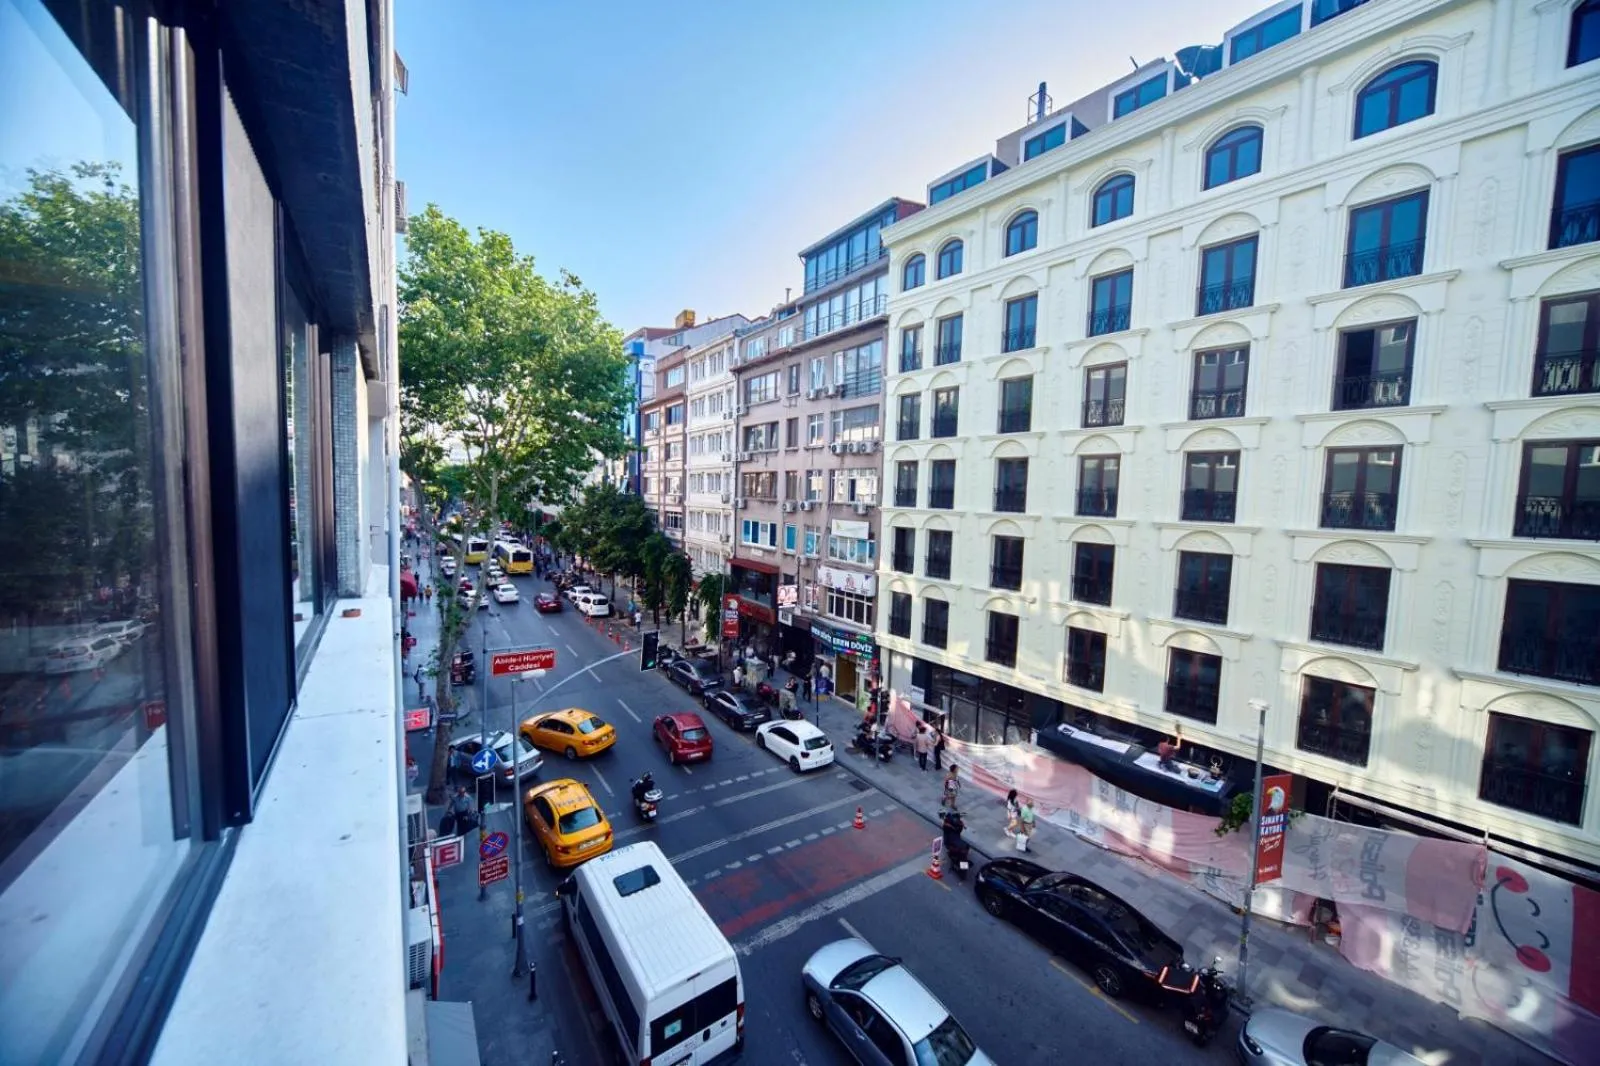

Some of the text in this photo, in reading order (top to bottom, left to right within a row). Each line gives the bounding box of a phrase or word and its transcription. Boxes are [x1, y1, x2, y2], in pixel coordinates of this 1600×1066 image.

[833, 637, 872, 653] EREN DÖVİZ
[508, 662, 541, 671] Caddesi
[440, 845, 456, 864] E
